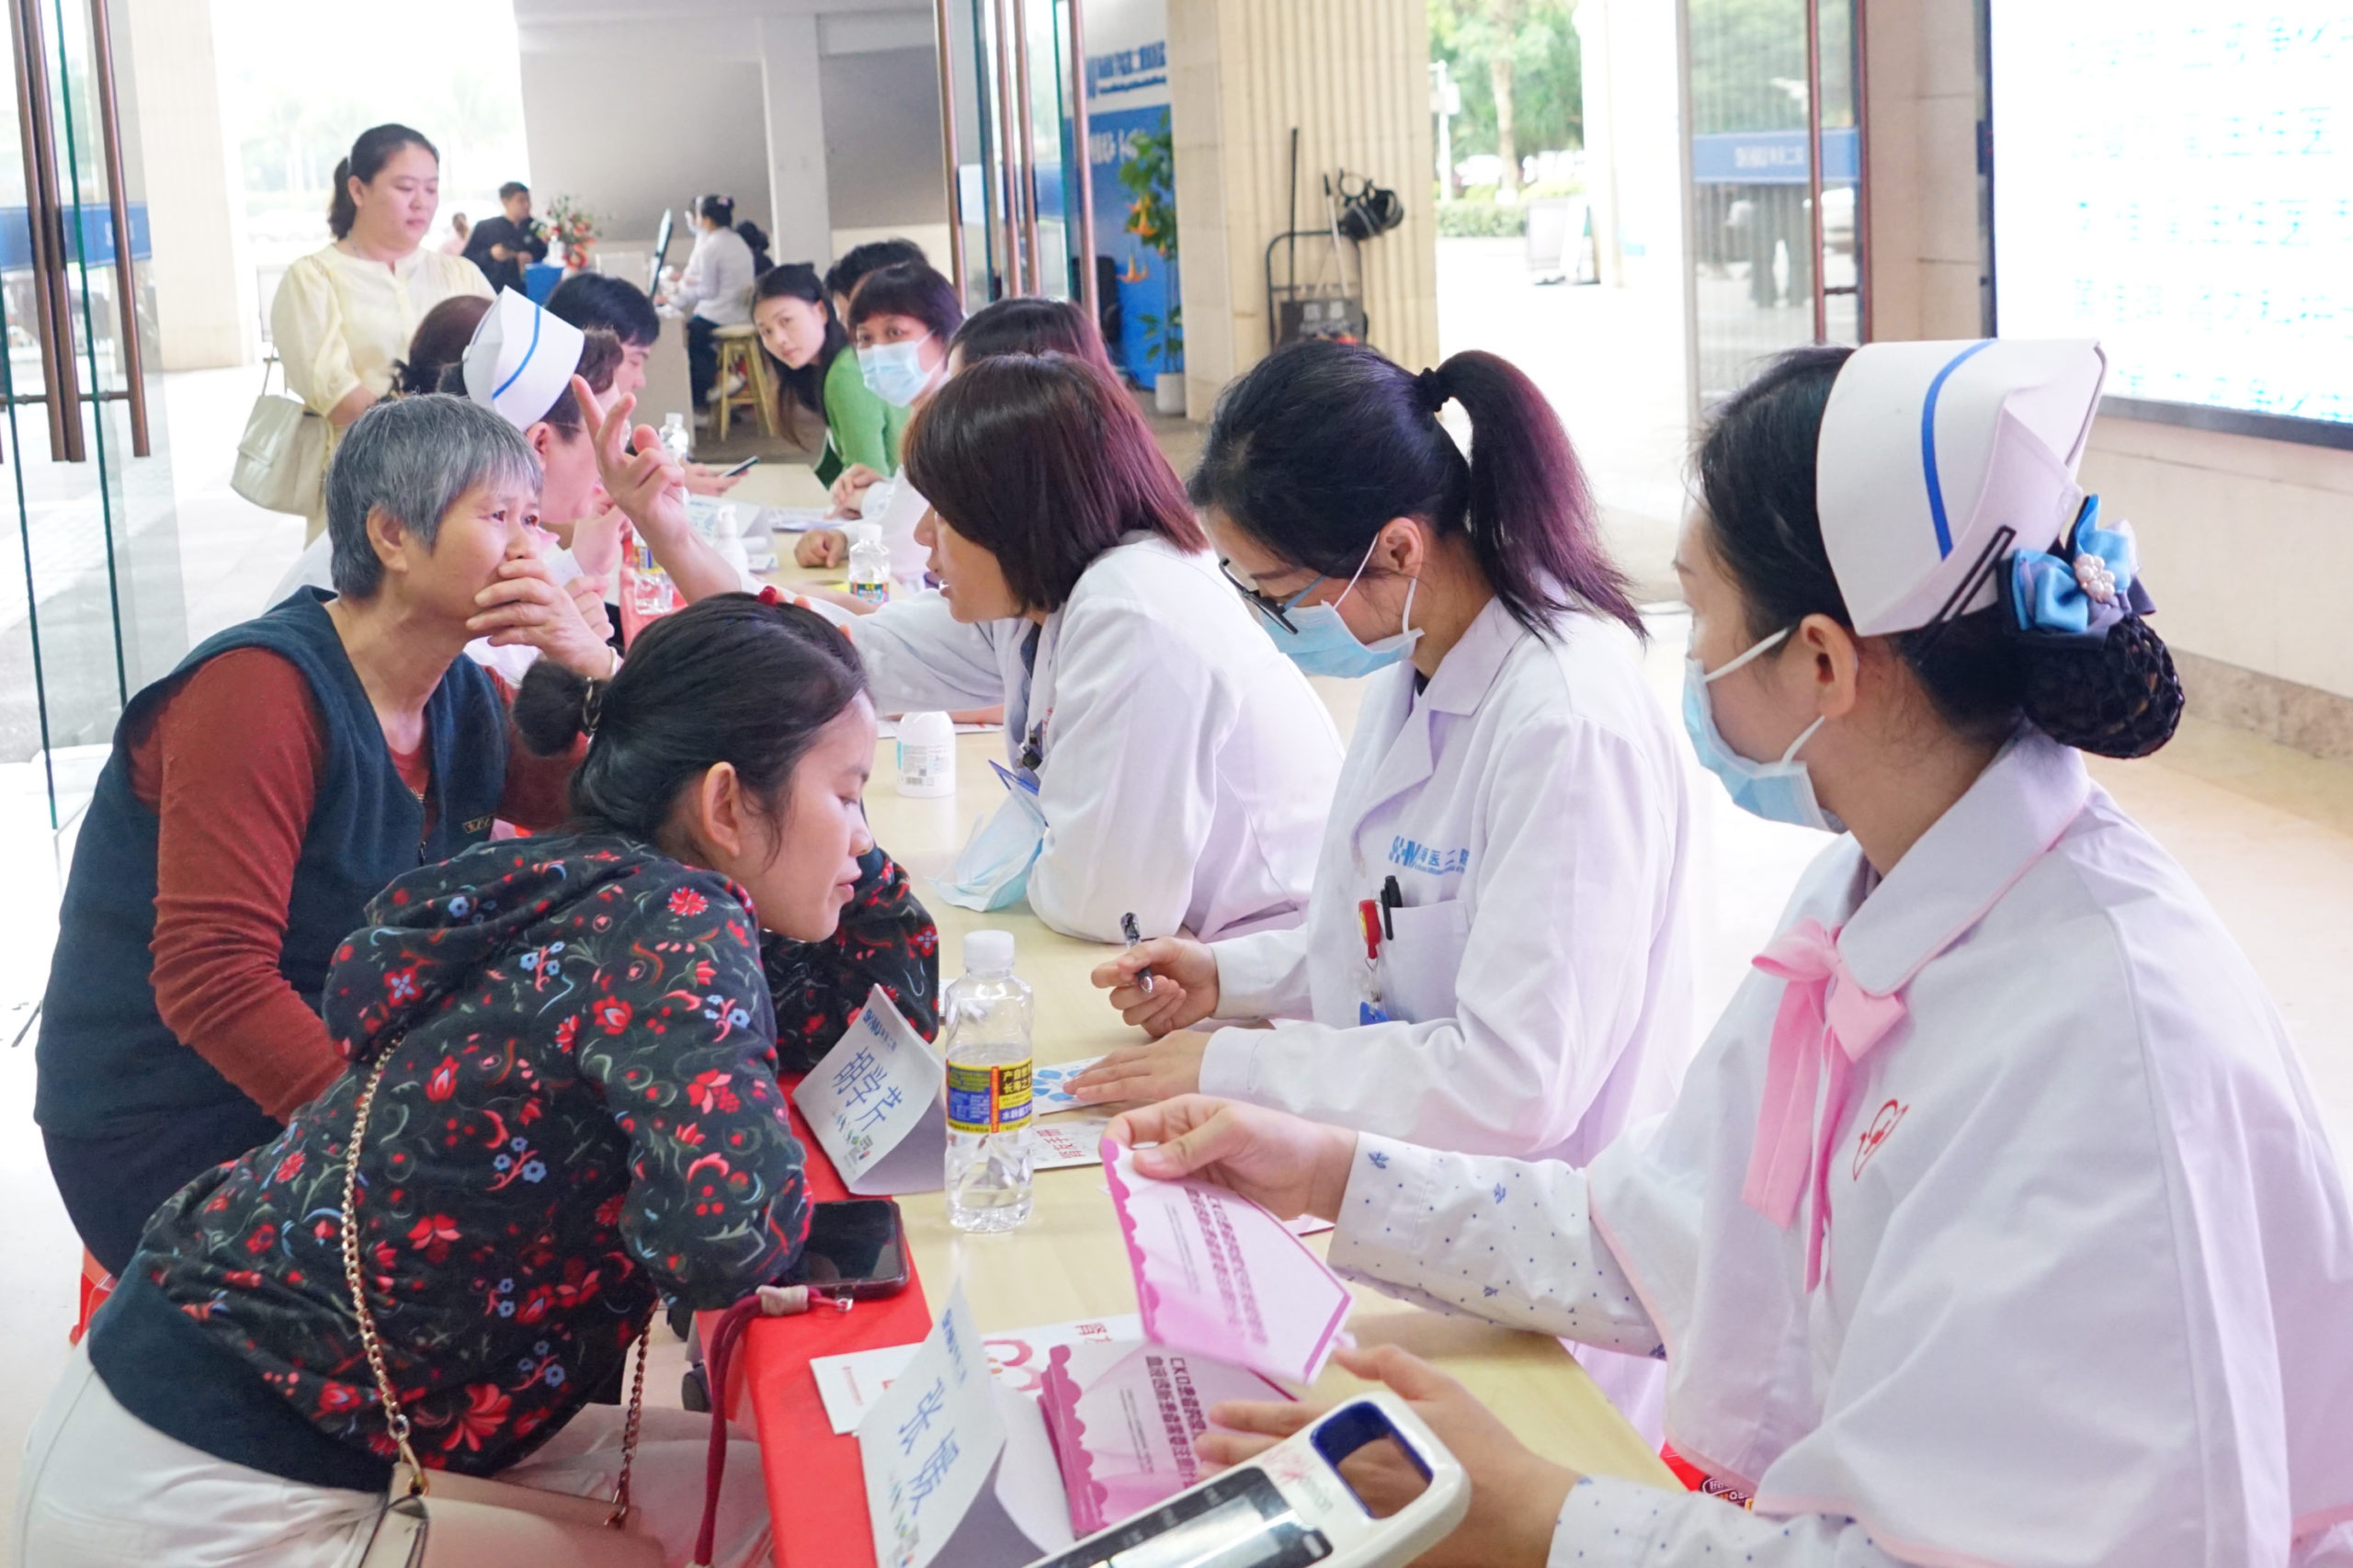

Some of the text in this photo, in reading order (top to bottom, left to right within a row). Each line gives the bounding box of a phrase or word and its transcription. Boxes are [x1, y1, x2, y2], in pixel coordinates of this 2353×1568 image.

[2183, 103, 2352, 163] 副主任医
[832, 1045, 904, 1132] 胡学芹
